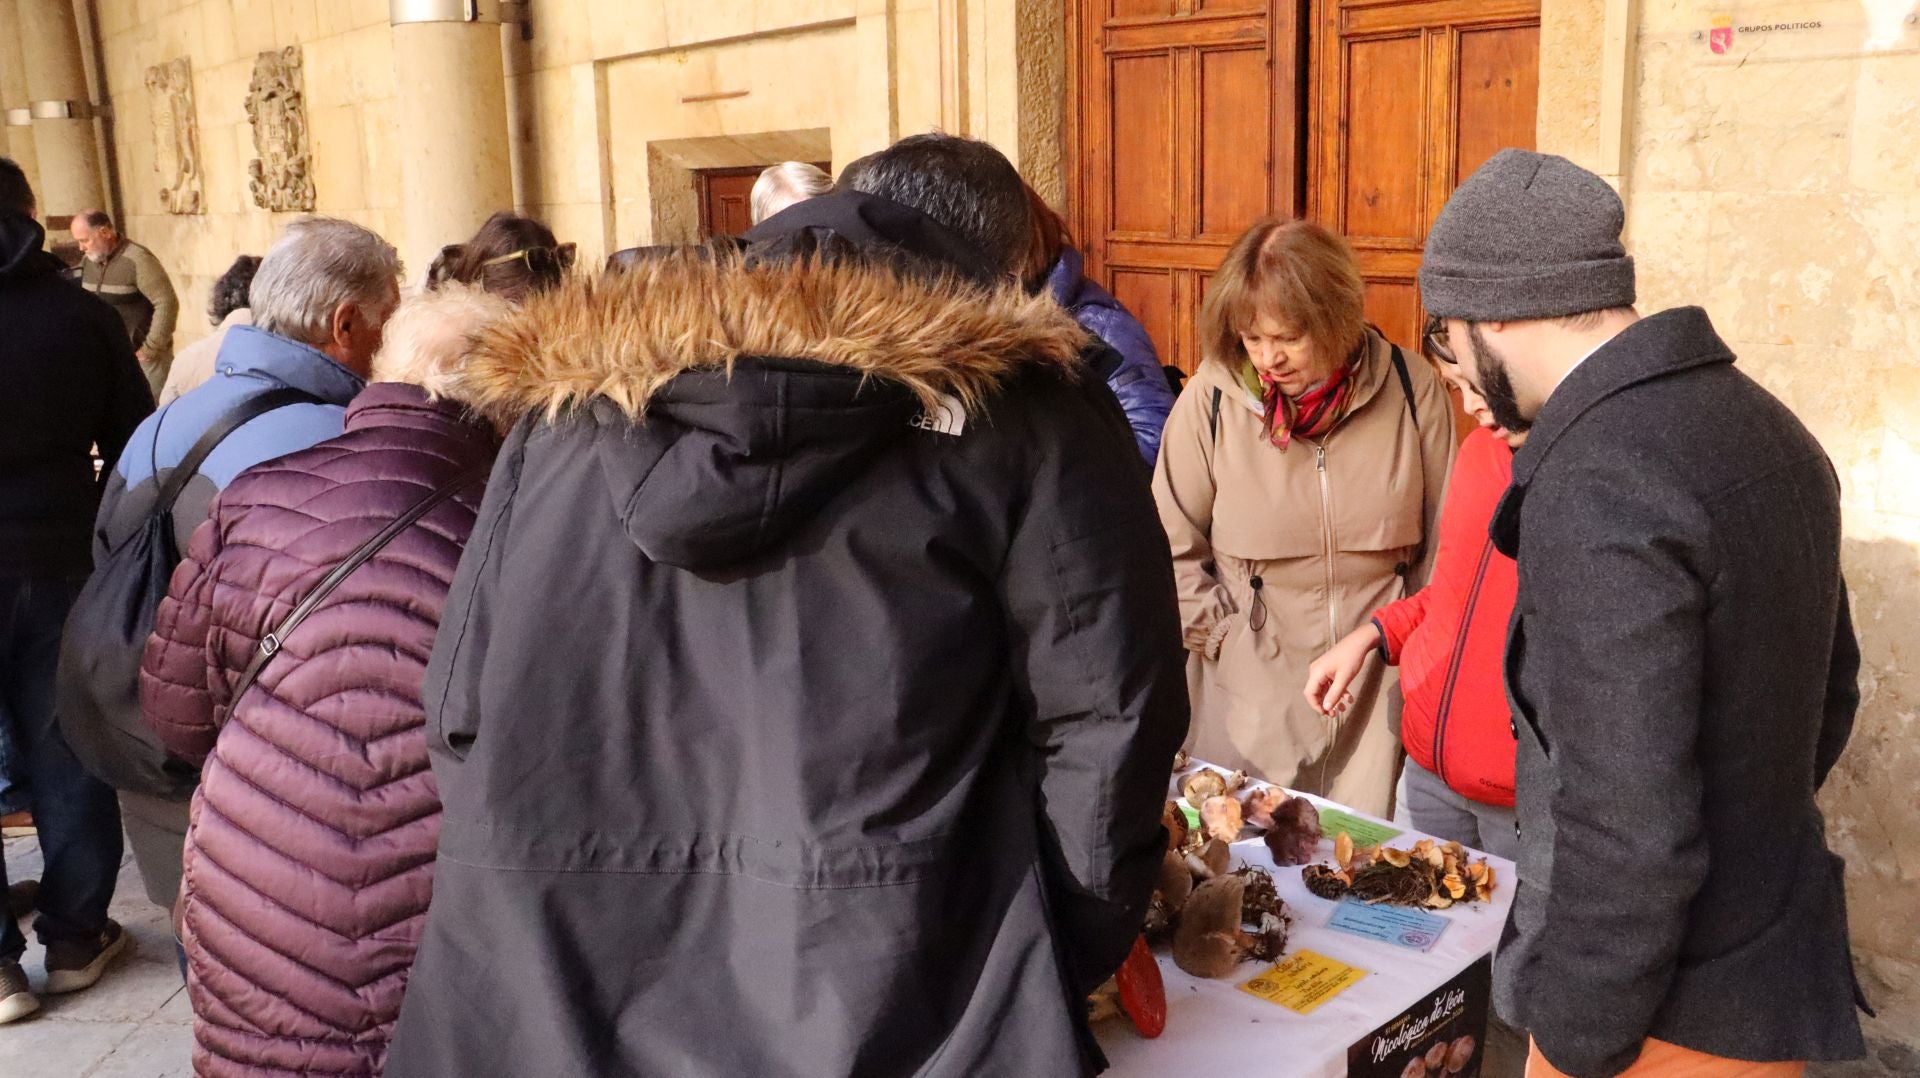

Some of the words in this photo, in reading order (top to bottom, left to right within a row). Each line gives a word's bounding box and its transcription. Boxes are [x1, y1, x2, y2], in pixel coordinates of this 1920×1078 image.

[1738, 24, 1773, 33] GRUPOS
[1774, 21, 1822, 31] POLITICOS
[907, 414, 933, 431] CE
[1430, 991, 1446, 1023] de
[1442, 988, 1465, 1017] León
